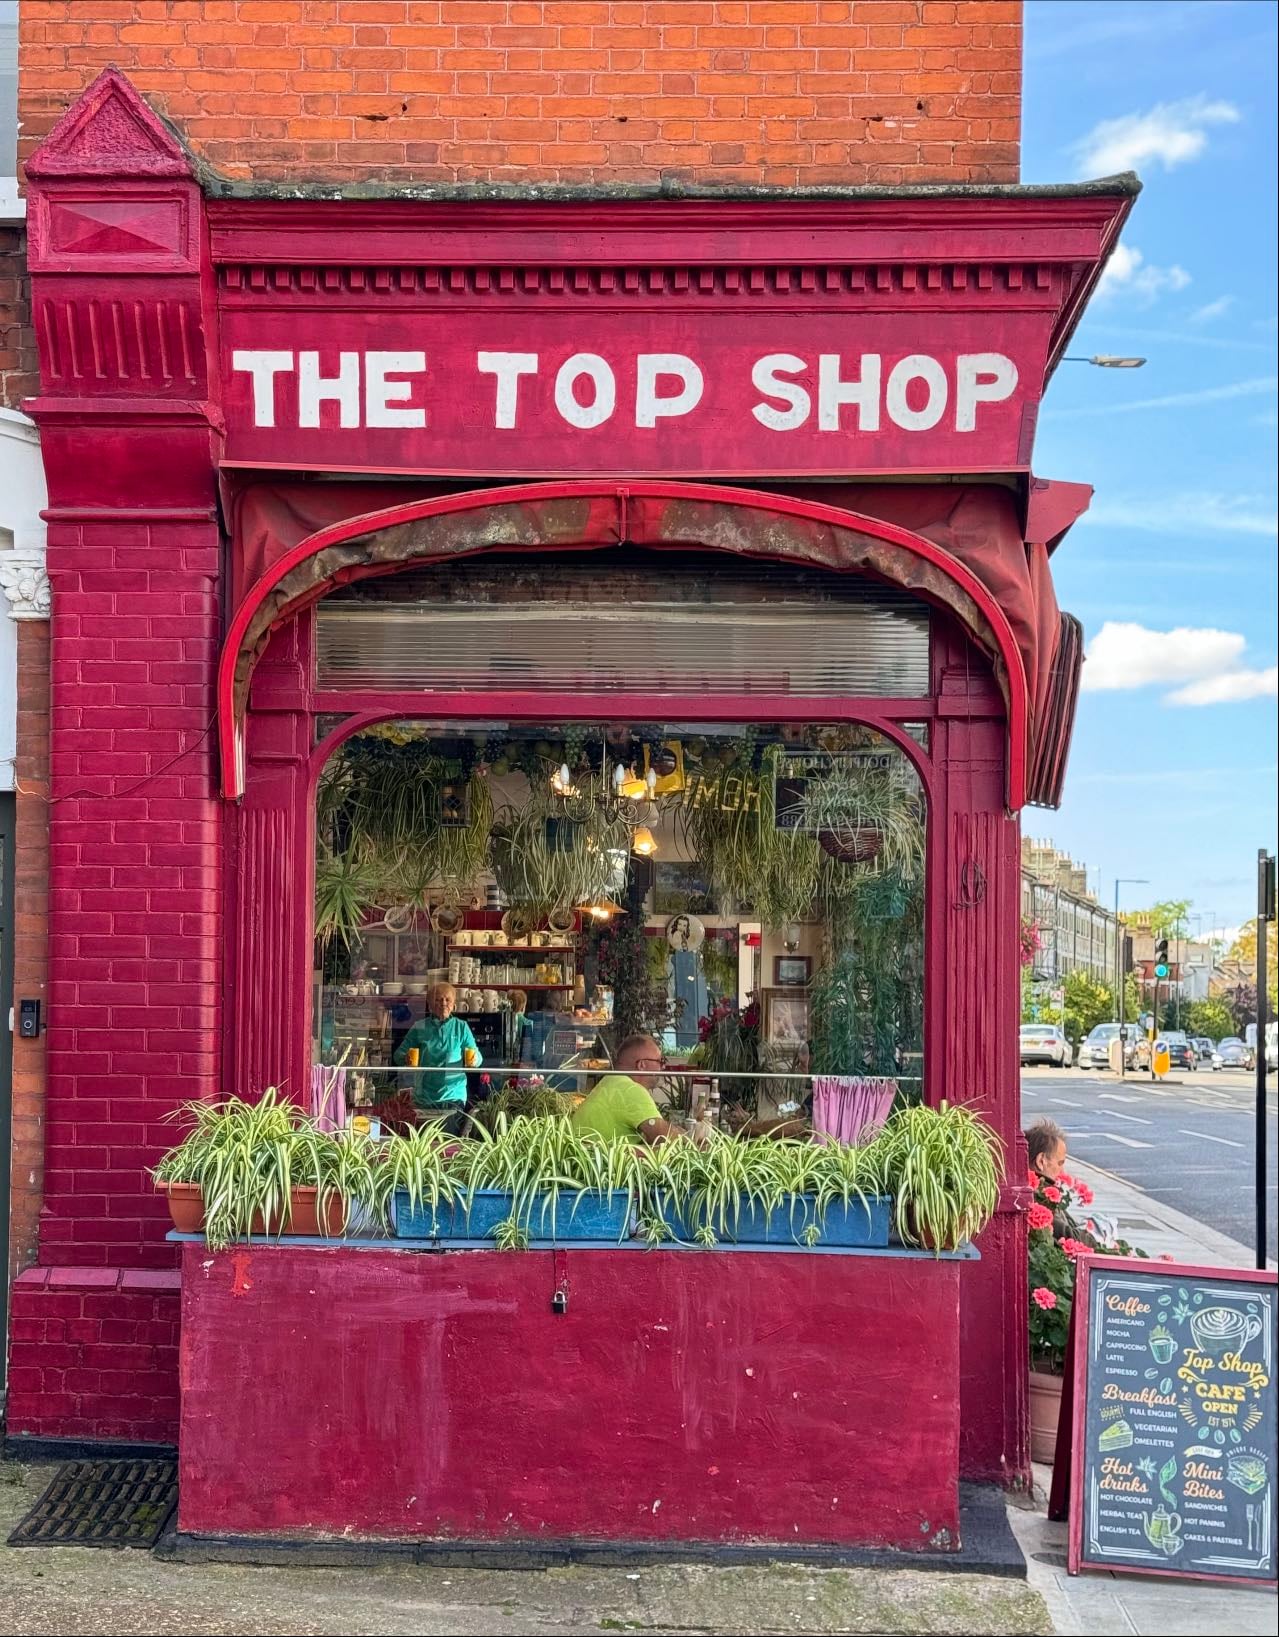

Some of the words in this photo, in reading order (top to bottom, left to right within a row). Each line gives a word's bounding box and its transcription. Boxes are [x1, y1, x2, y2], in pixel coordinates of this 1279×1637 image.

[231, 350, 427, 429] THE
[477, 352, 704, 430] TOP
[751, 352, 1019, 433] SHOP
[1106, 1295, 1151, 1316] Coffee
[1106, 1318, 1145, 1327] AMERICANO
[1106, 1330, 1130, 1338] MOCHA
[1106, 1342, 1147, 1352] CAPPUCCINO
[1106, 1354, 1124, 1362] LATTE
[1183, 1348, 1215, 1374] Top
[1218, 1352, 1264, 1379] Shop
[1105, 1367, 1138, 1376] ESPRESSO
[1102, 1384, 1178, 1408] Breakfast
[1195, 1382, 1246, 1401] CAFE
[1130, 1408, 1146, 1416] FULL
[1147, 1409, 1177, 1418] ENGLISH
[1202, 1402, 1238, 1414] OPEN
[1208, 1416, 1219, 1427] EST
[1134, 1423, 1178, 1434] VEGETARIAN
[1134, 1438, 1174, 1448] OMELETTES
[1100, 1457, 1134, 1476] Hot
[1183, 1462, 1224, 1480] Mini
[1100, 1475, 1150, 1494] drinks
[1183, 1480, 1225, 1500] Bites
[1100, 1494, 1114, 1502] HOT
[1115, 1494, 1152, 1505] CHOCOLATE
[1184, 1501, 1227, 1512] SANDWICHES
[1100, 1510, 1125, 1519] HERBAL
[1126, 1512, 1143, 1520] TEAS
[1199, 1519, 1225, 1528] PANINIS
[1100, 1526, 1127, 1534] ENGLISH
[1128, 1528, 1141, 1536] TEA
[1184, 1534, 1206, 1542] CAKES
[1213, 1536, 1243, 1545] PASTRIES
